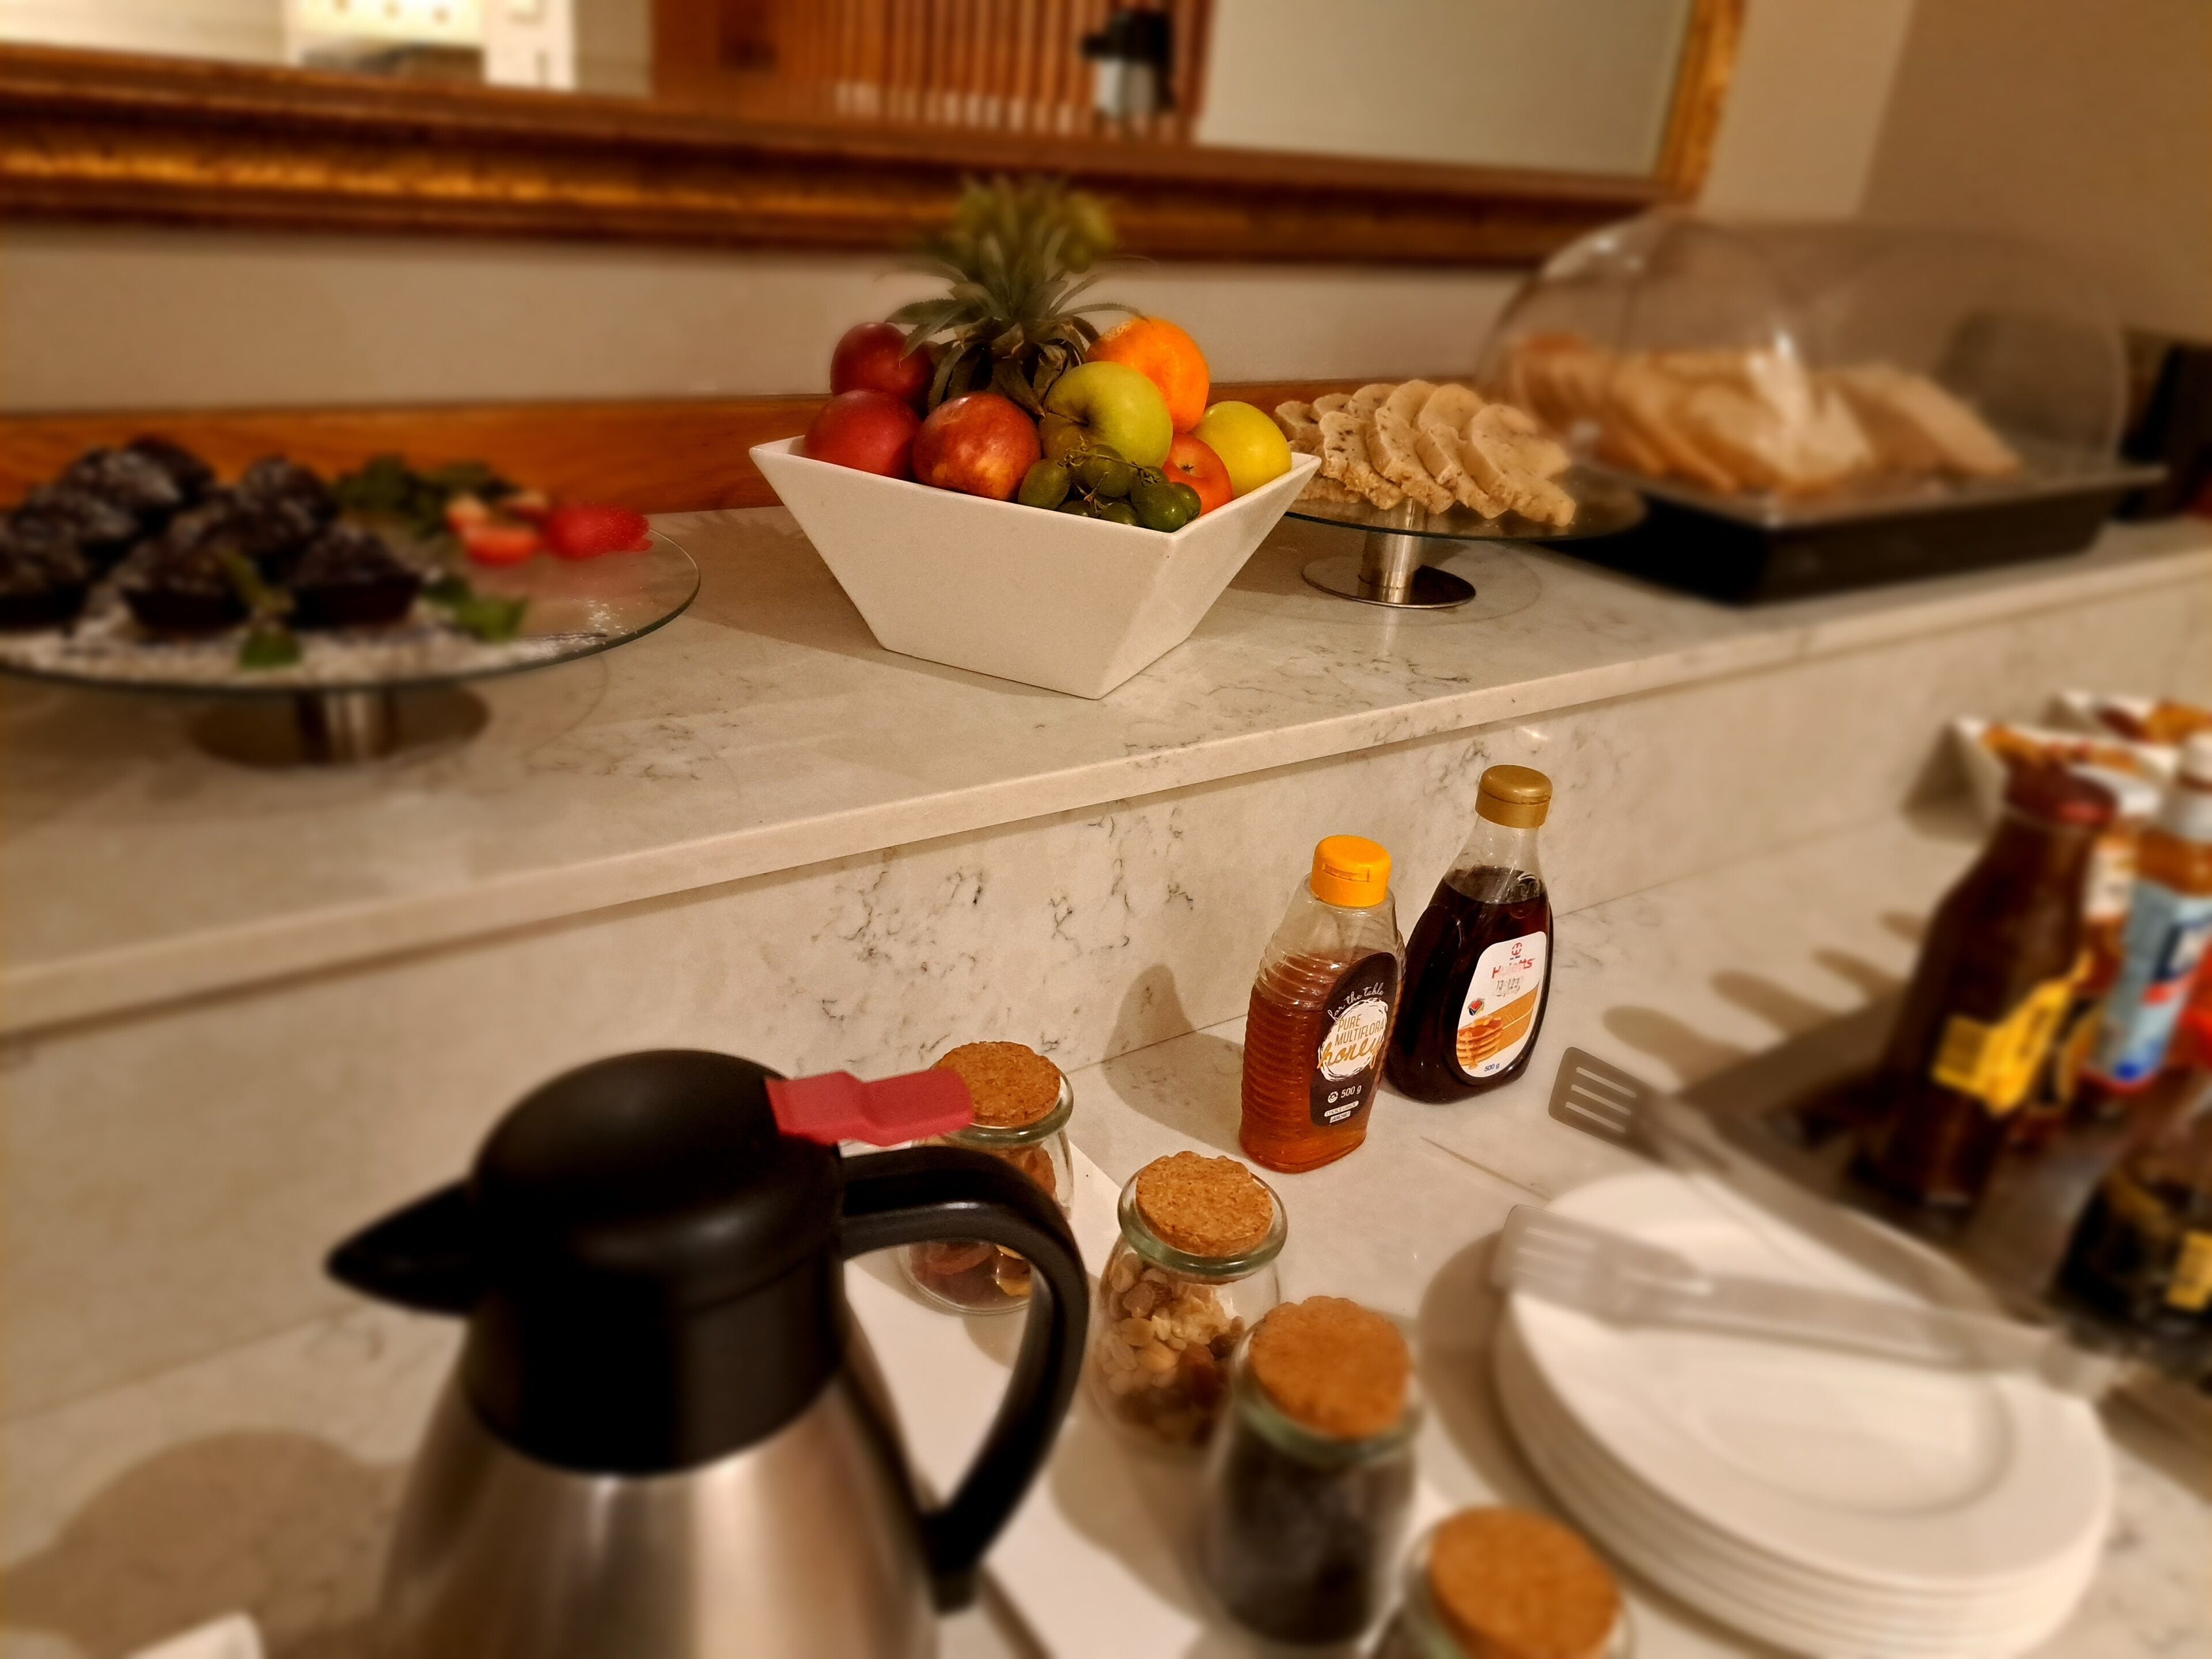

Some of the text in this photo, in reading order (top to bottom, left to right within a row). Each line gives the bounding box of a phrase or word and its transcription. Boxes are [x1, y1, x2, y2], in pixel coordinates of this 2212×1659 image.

[1327, 982, 1385, 1023] for the table
[1334, 1018, 1385, 1047] MULTIFLORA
[1337, 1013, 1362, 1032] PURE
[1317, 1036, 1384, 1070] honey
[1340, 1085, 1362, 1099] 500 g
